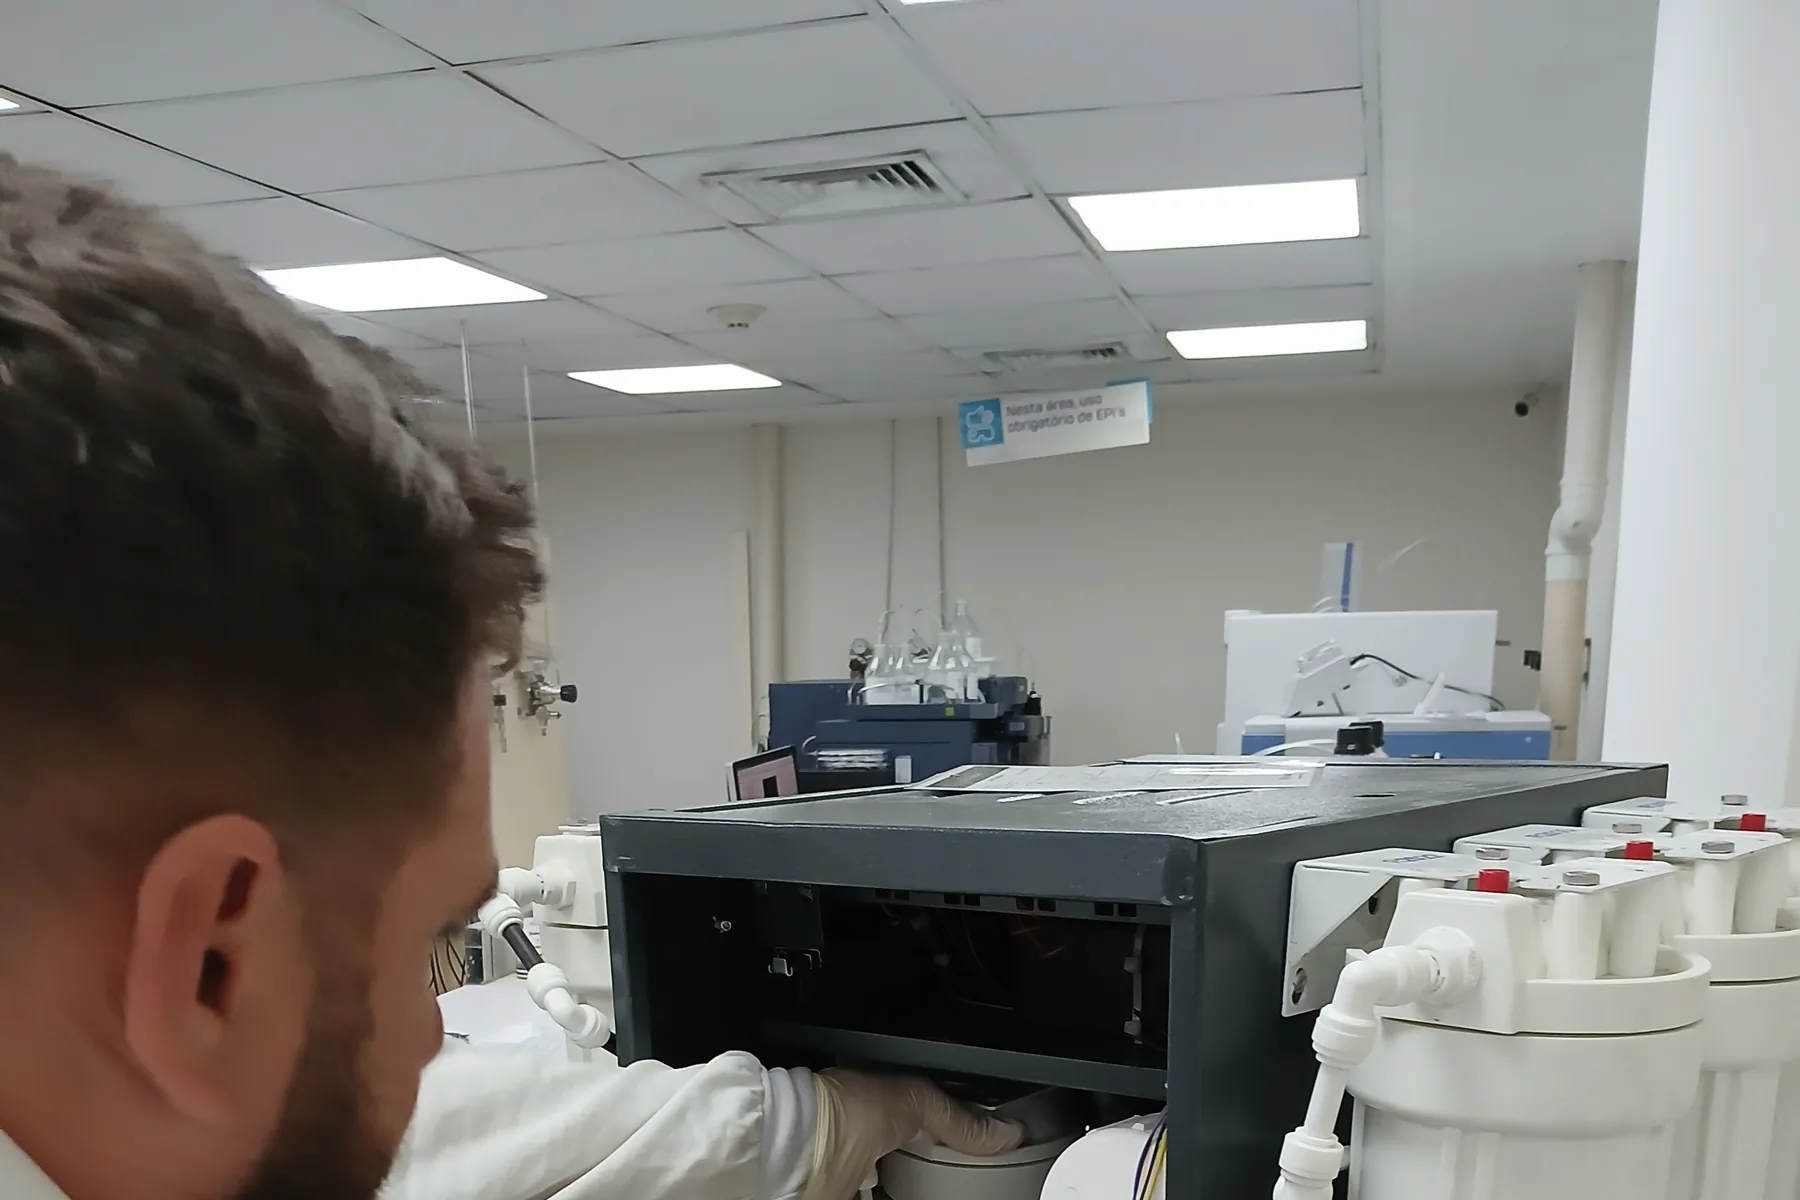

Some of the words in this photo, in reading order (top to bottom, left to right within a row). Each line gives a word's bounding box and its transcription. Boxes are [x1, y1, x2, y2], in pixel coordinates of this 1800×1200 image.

[1006, 402, 1043, 417] Nesta
[1079, 394, 1103, 406] uso
[1007, 411, 1075, 433] obrigatório
[1077, 410, 1094, 423] de
